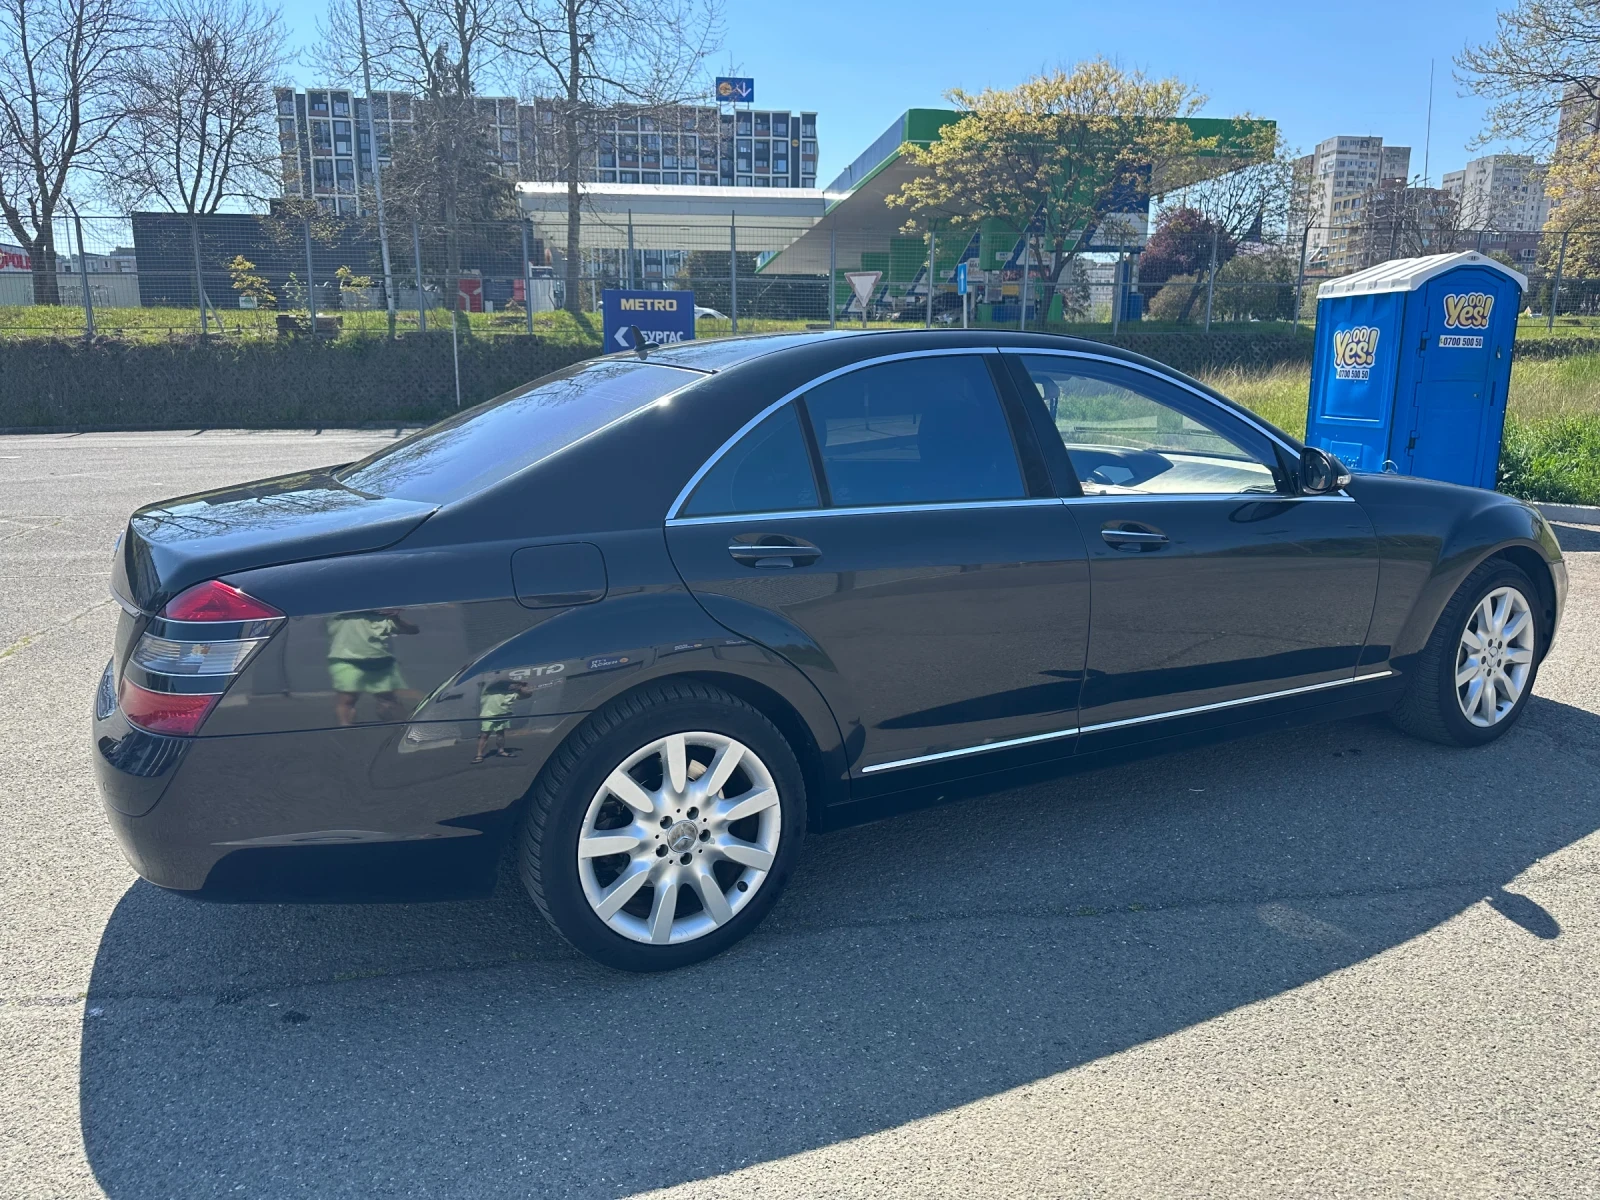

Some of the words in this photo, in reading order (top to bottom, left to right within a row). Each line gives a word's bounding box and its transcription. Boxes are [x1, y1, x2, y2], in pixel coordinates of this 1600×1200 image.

[620, 298, 677, 311] METRO
[1446, 295, 1492, 327] Yes!
[1335, 329, 1378, 366] Yes!
[1443, 337, 1460, 346] 0700
[1462, 337, 1474, 347] 500
[1361, 370, 1368, 379] 50
